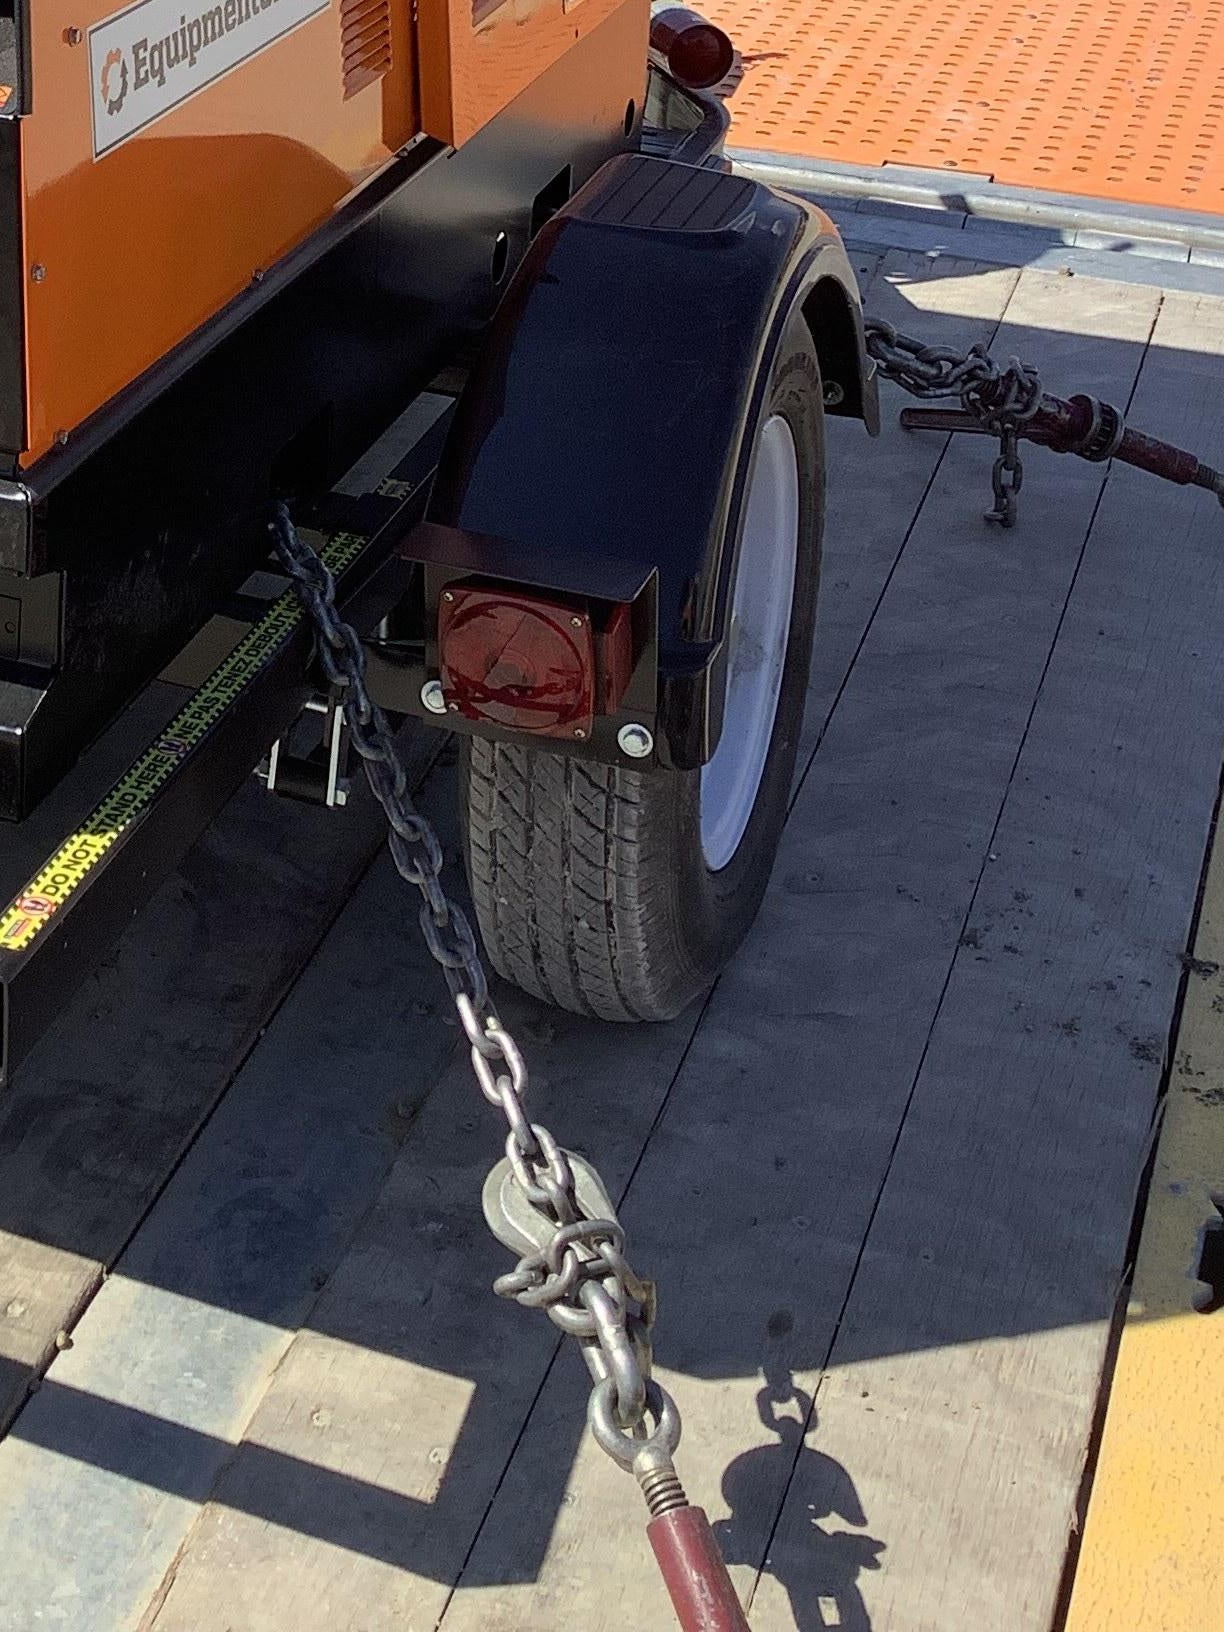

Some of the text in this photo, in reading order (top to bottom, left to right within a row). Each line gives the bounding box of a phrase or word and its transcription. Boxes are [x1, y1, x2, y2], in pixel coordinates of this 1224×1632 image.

[40, 873, 70, 897] DO
[63, 838, 97, 871] NOT
[92, 792, 137, 839] STAND
[133, 753, 171, 792] HERE
[173, 718, 200, 739] NE
[189, 695, 221, 720] PAS
